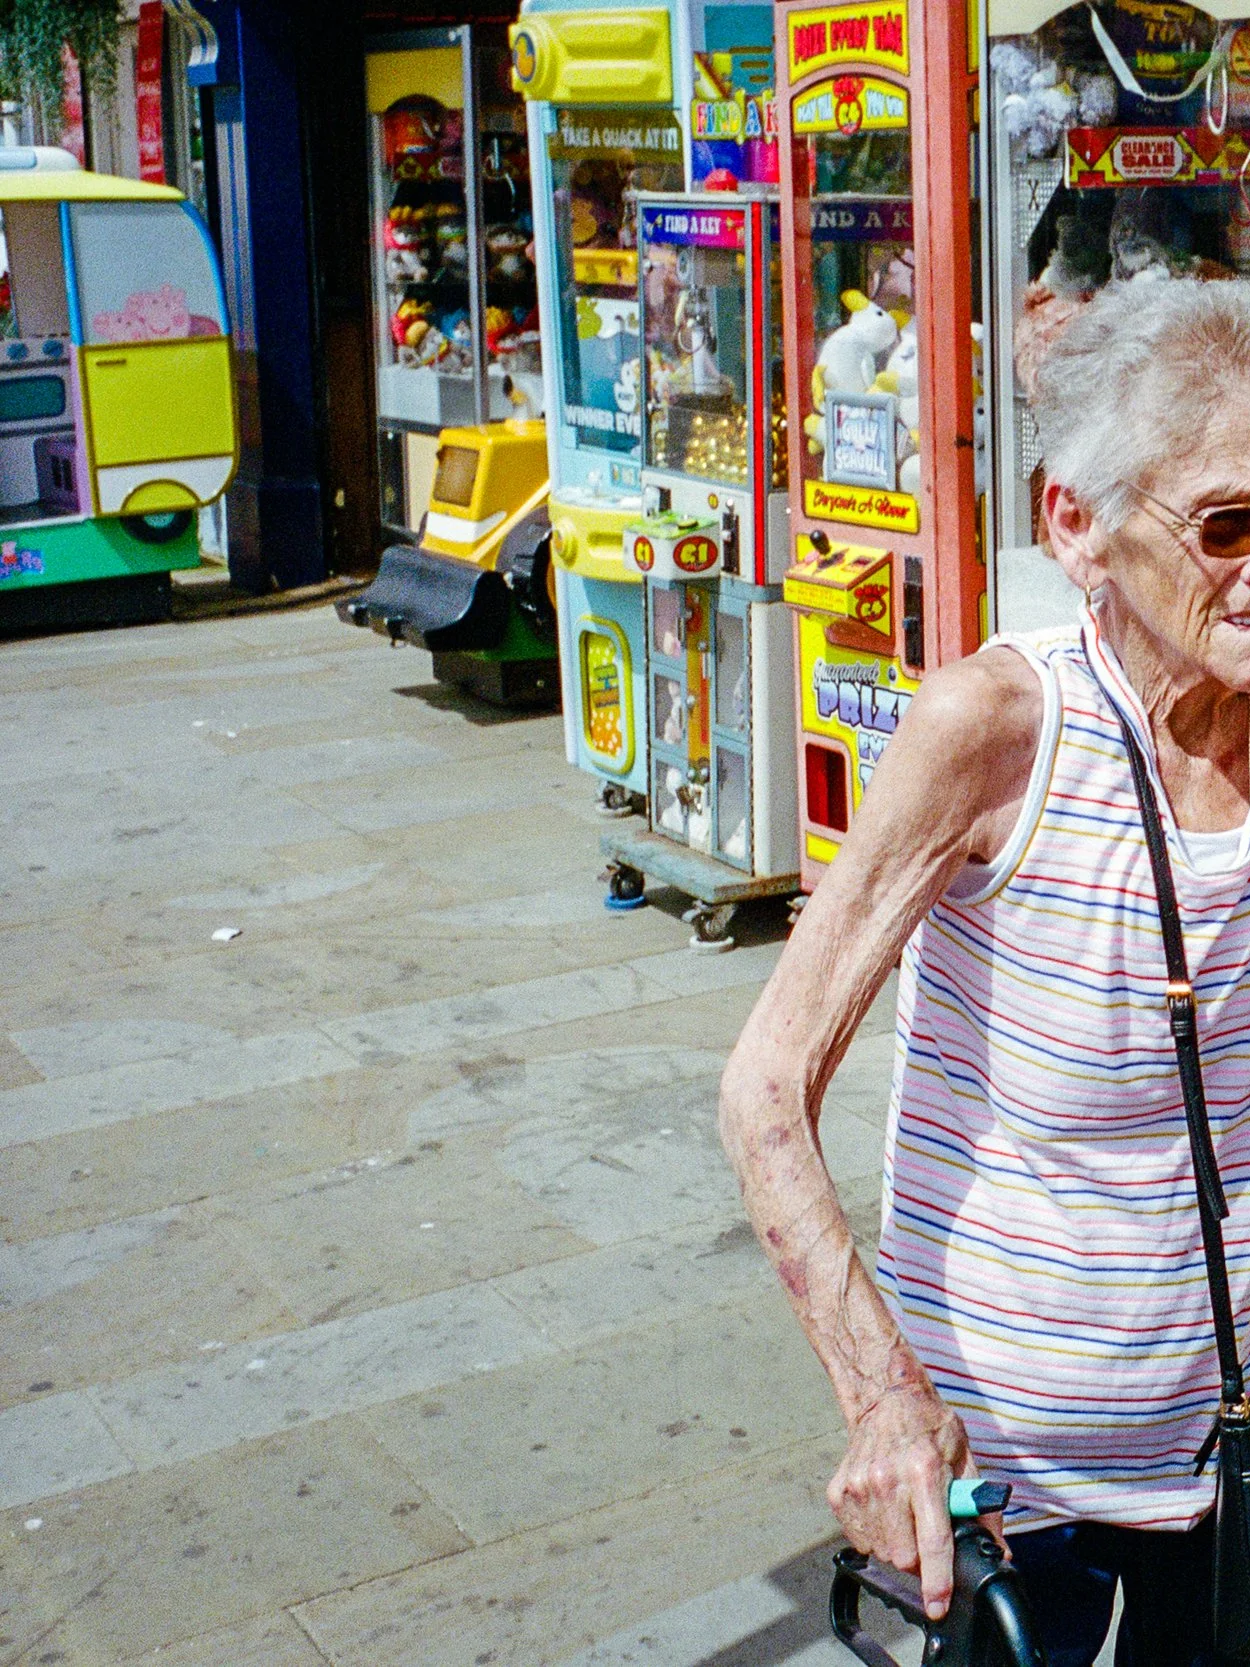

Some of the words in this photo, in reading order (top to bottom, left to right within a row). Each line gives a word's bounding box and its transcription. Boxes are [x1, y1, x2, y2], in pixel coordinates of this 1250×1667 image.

[696, 101, 741, 136] FIND
[745, 100, 761, 136] A
[561, 126, 591, 147] TAKE
[592, 128, 601, 148] A
[603, 127, 643, 149] QUACK
[645, 128, 660, 150] AT
[1122, 154, 1175, 168] SALE
[664, 214, 688, 234] FIND
[690, 217, 698, 234] A
[700, 217, 722, 235] KEY
[810, 210, 855, 228] IND
[864, 211, 882, 228] A
[565, 405, 615, 432] WINNER
